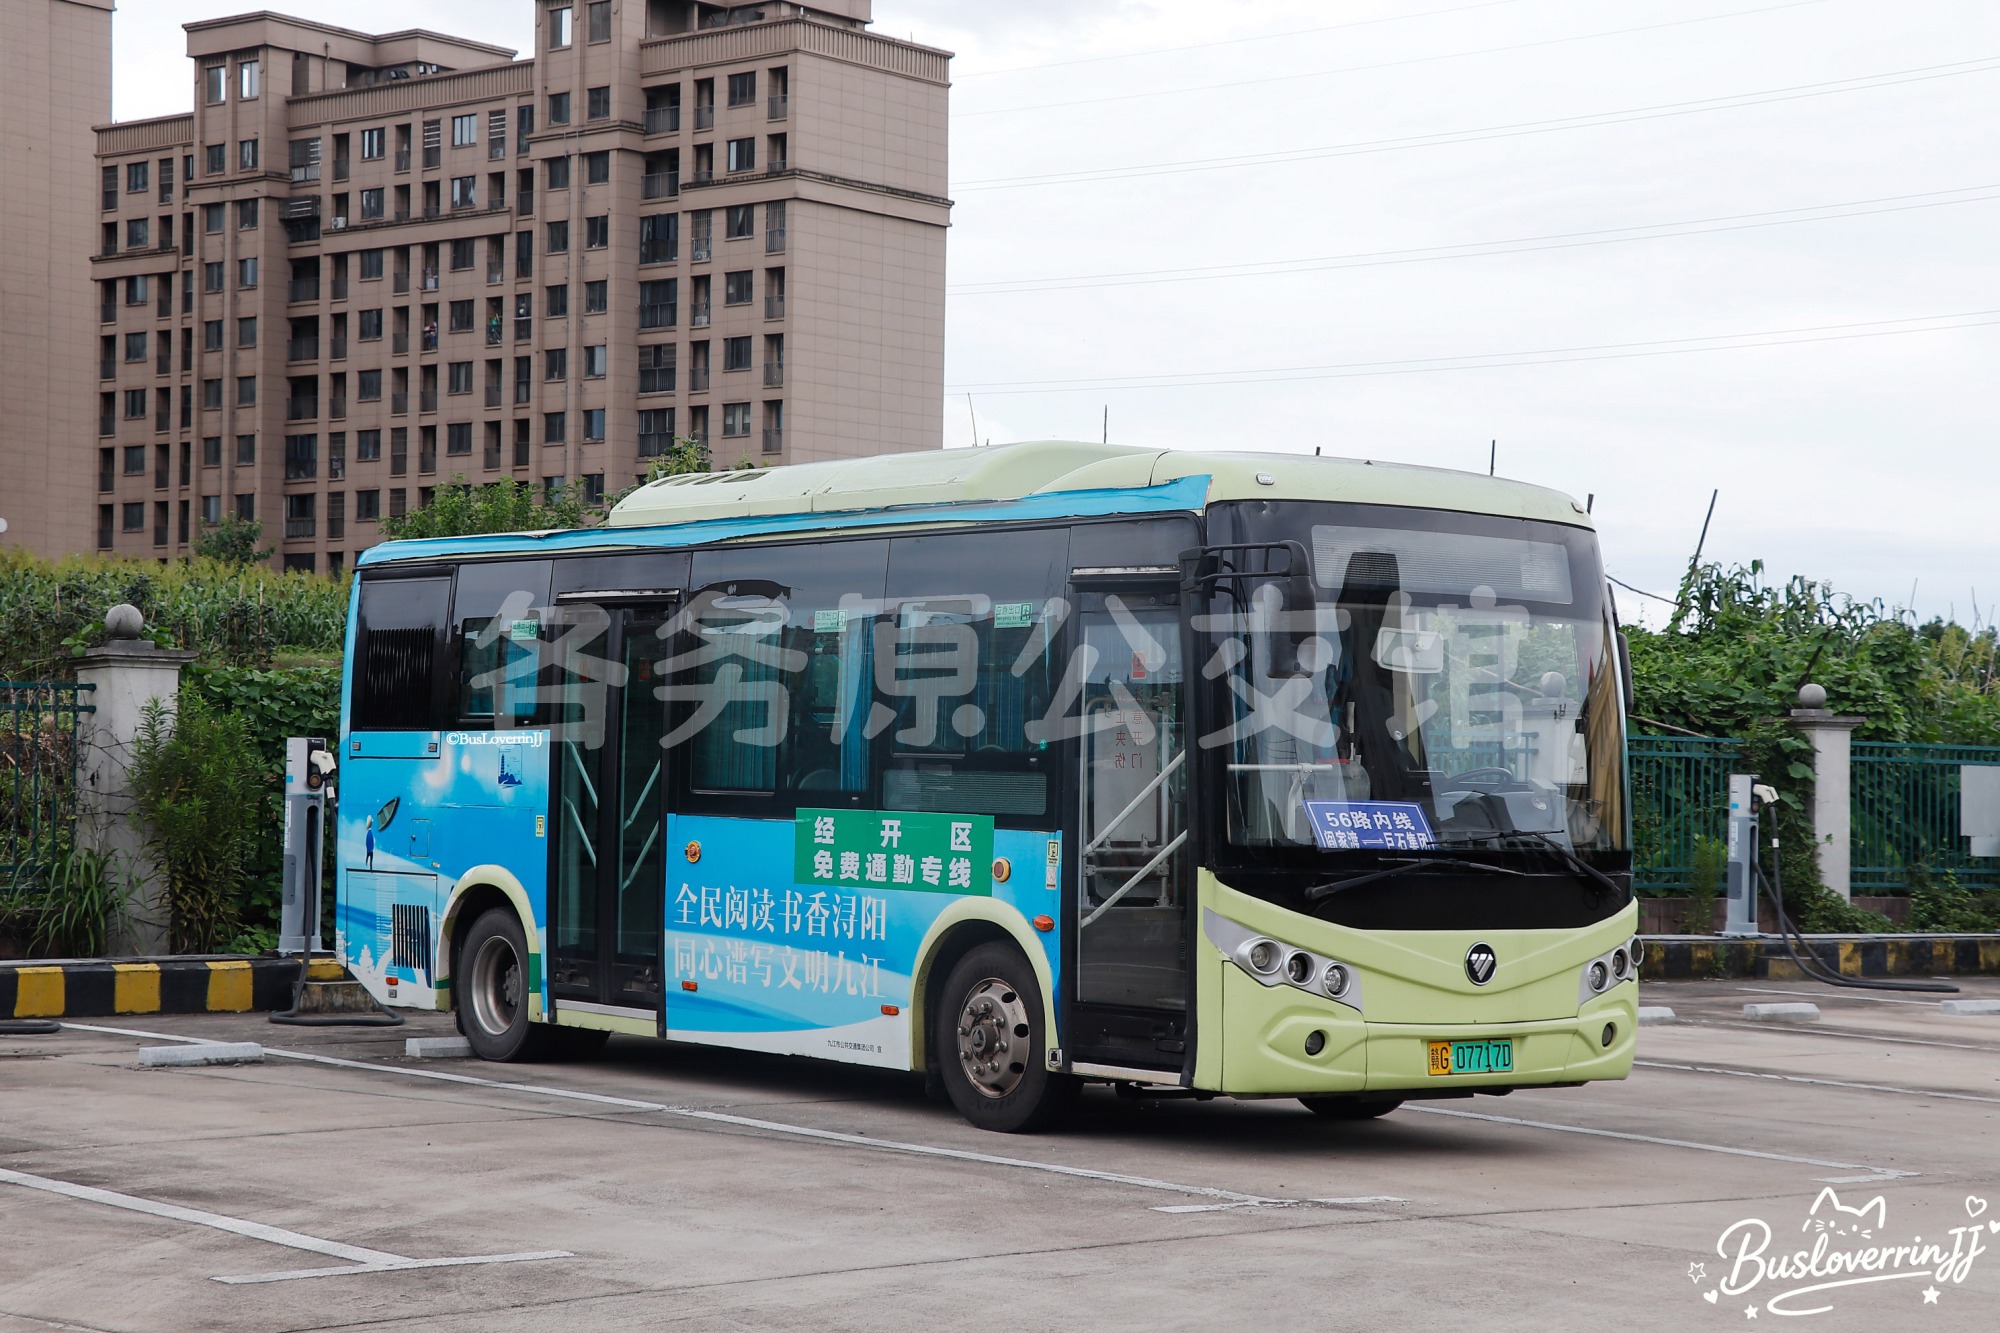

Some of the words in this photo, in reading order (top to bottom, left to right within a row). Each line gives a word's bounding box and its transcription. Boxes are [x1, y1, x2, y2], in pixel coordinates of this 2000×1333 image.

[813, 816, 972, 852] 经开区
[1325, 811, 1415, 831] 56路内线
[813, 849, 972, 888] 免费通勤专线
[674, 882, 887, 942] 全民阅读书香浔阳
[674, 937, 887, 999] 同心谱写文明九江
